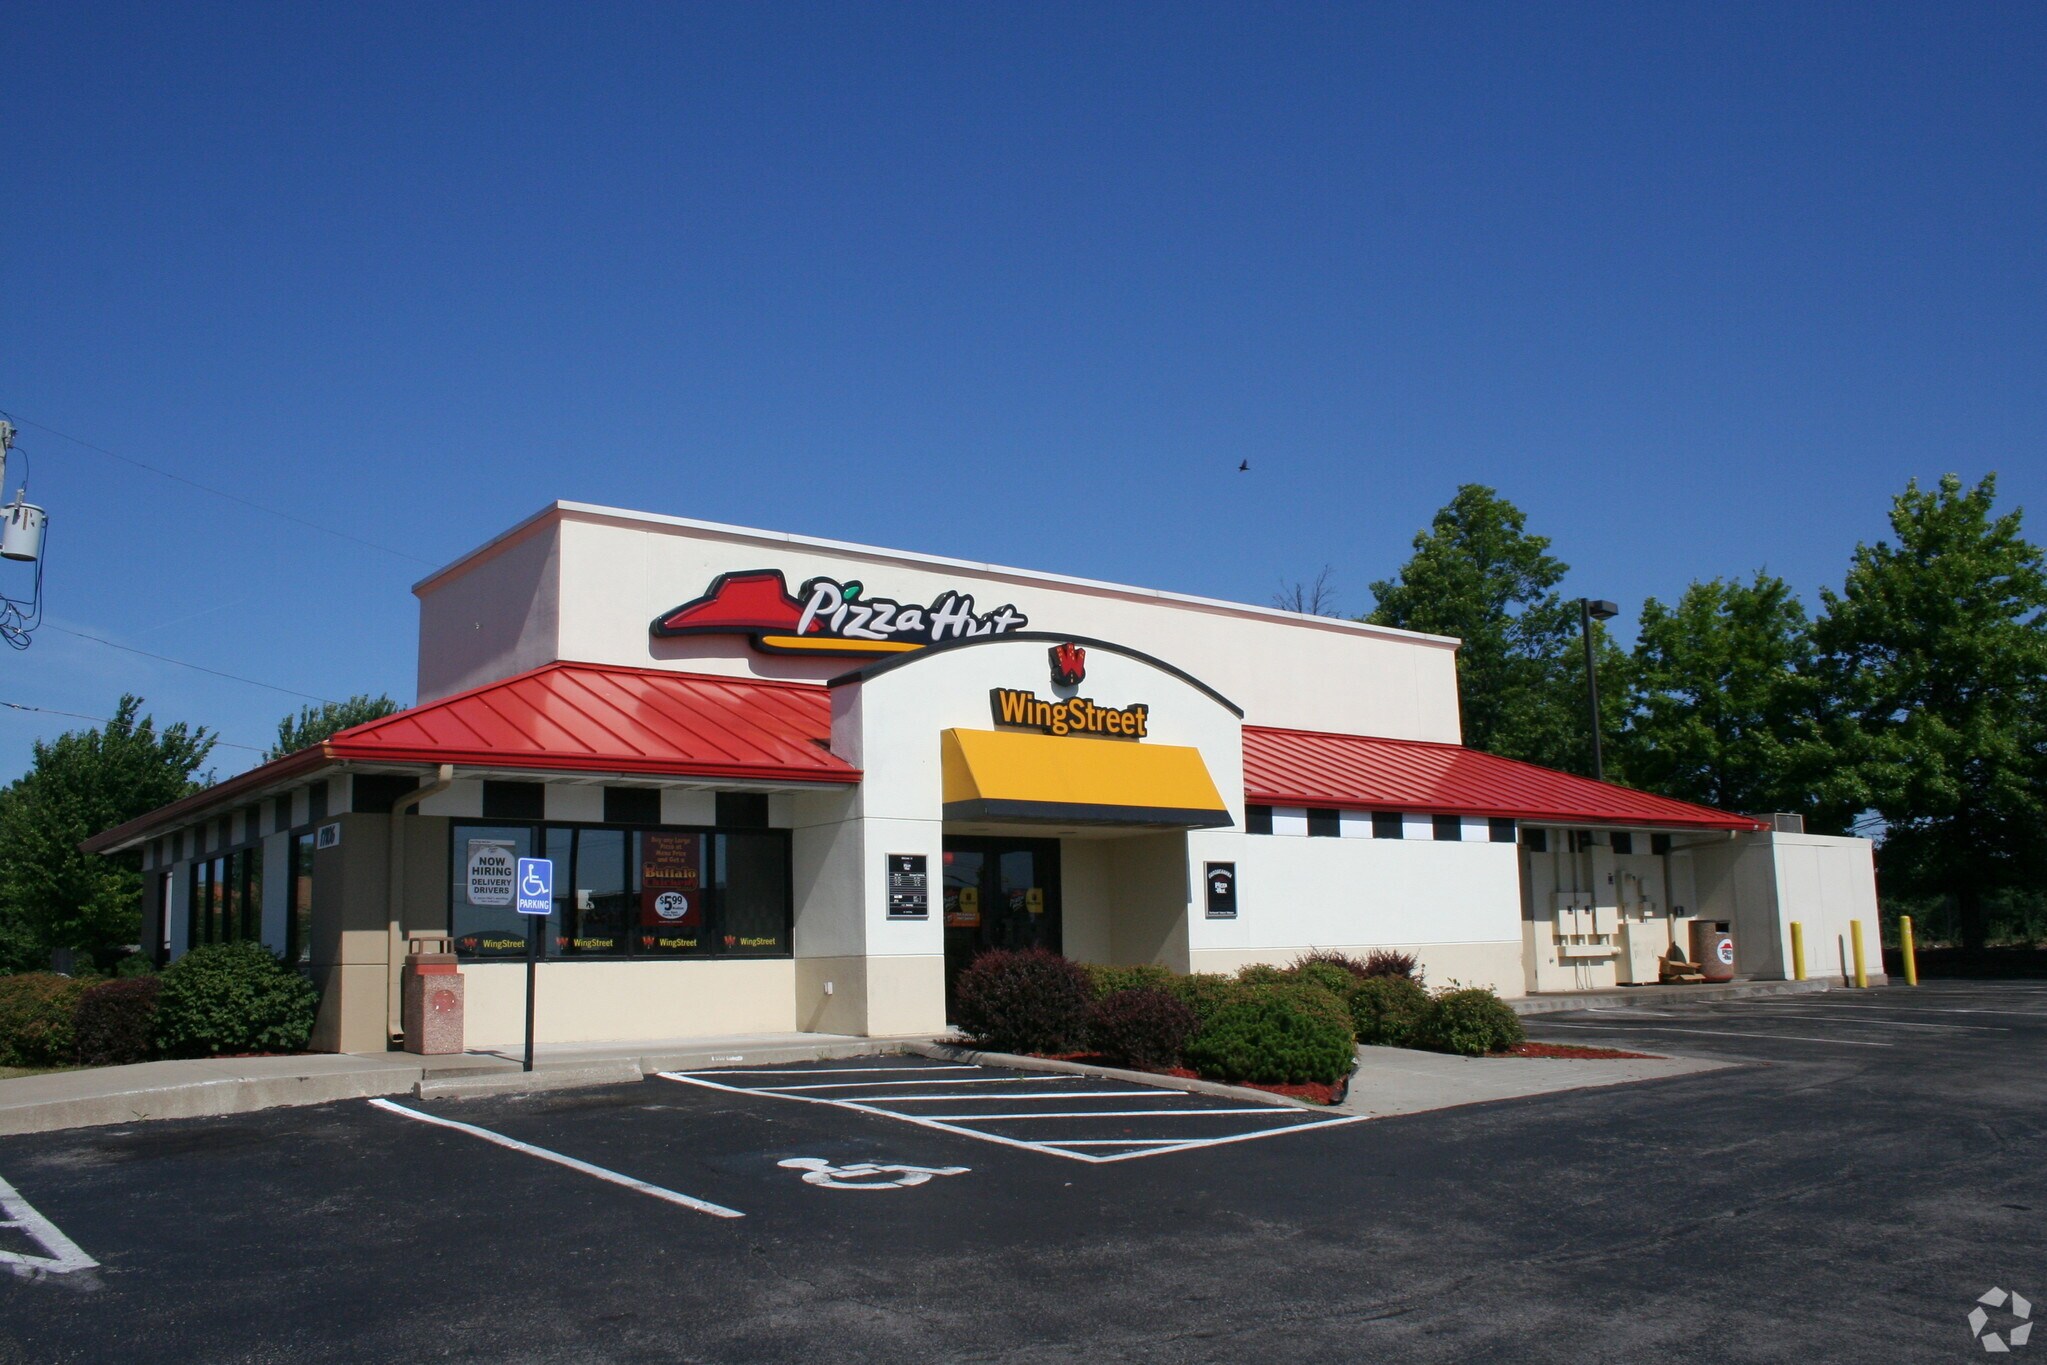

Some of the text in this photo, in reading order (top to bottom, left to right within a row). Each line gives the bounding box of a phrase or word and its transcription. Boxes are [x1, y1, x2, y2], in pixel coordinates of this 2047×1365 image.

[797, 581, 1025, 642] Pizza Hut
[999, 690, 1146, 736] WingStreet
[479, 857, 506, 866] NOW
[472, 867, 512, 876] HIRING
[520, 899, 549, 909] PARKING
[483, 939, 525, 949] WingStreet
[573, 938, 613, 948] WingStreet
[659, 938, 697, 948] WingStreet
[740, 937, 776, 947] WingStreet
